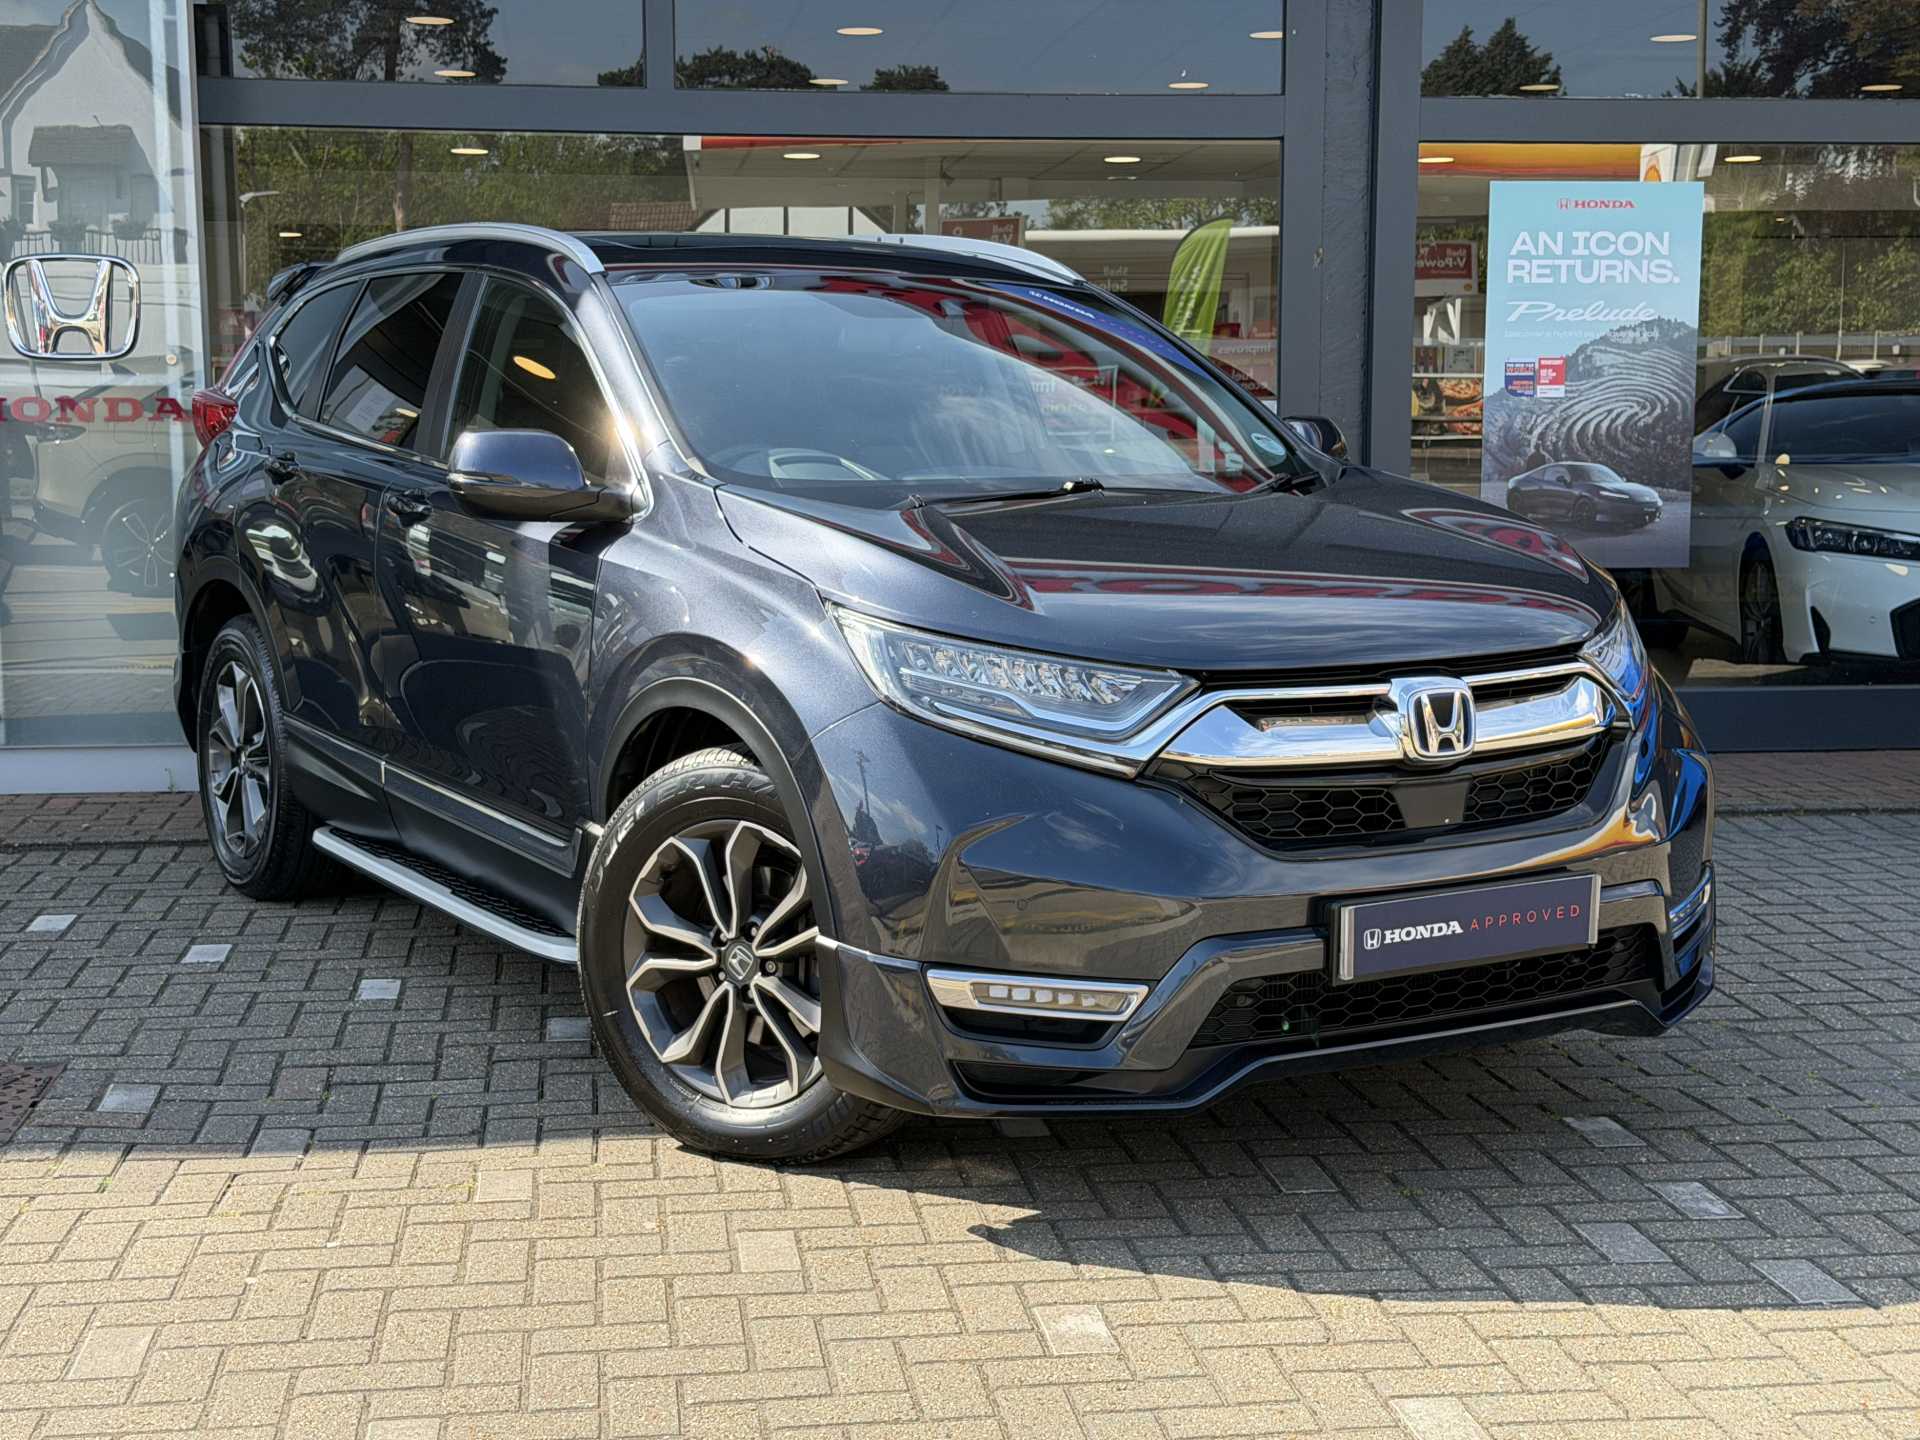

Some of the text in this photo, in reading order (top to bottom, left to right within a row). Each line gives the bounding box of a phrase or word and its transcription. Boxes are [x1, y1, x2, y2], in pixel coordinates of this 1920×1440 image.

[1574, 199, 1636, 209] HONDA
[1509, 231, 1670, 256] AN ICON
[1506, 259, 1681, 284] RETURNS.
[1505, 300, 1659, 322] Prelude
[0, 396, 193, 423] ONDA
[1383, 904, 1580, 944] HONDA APPROVED
